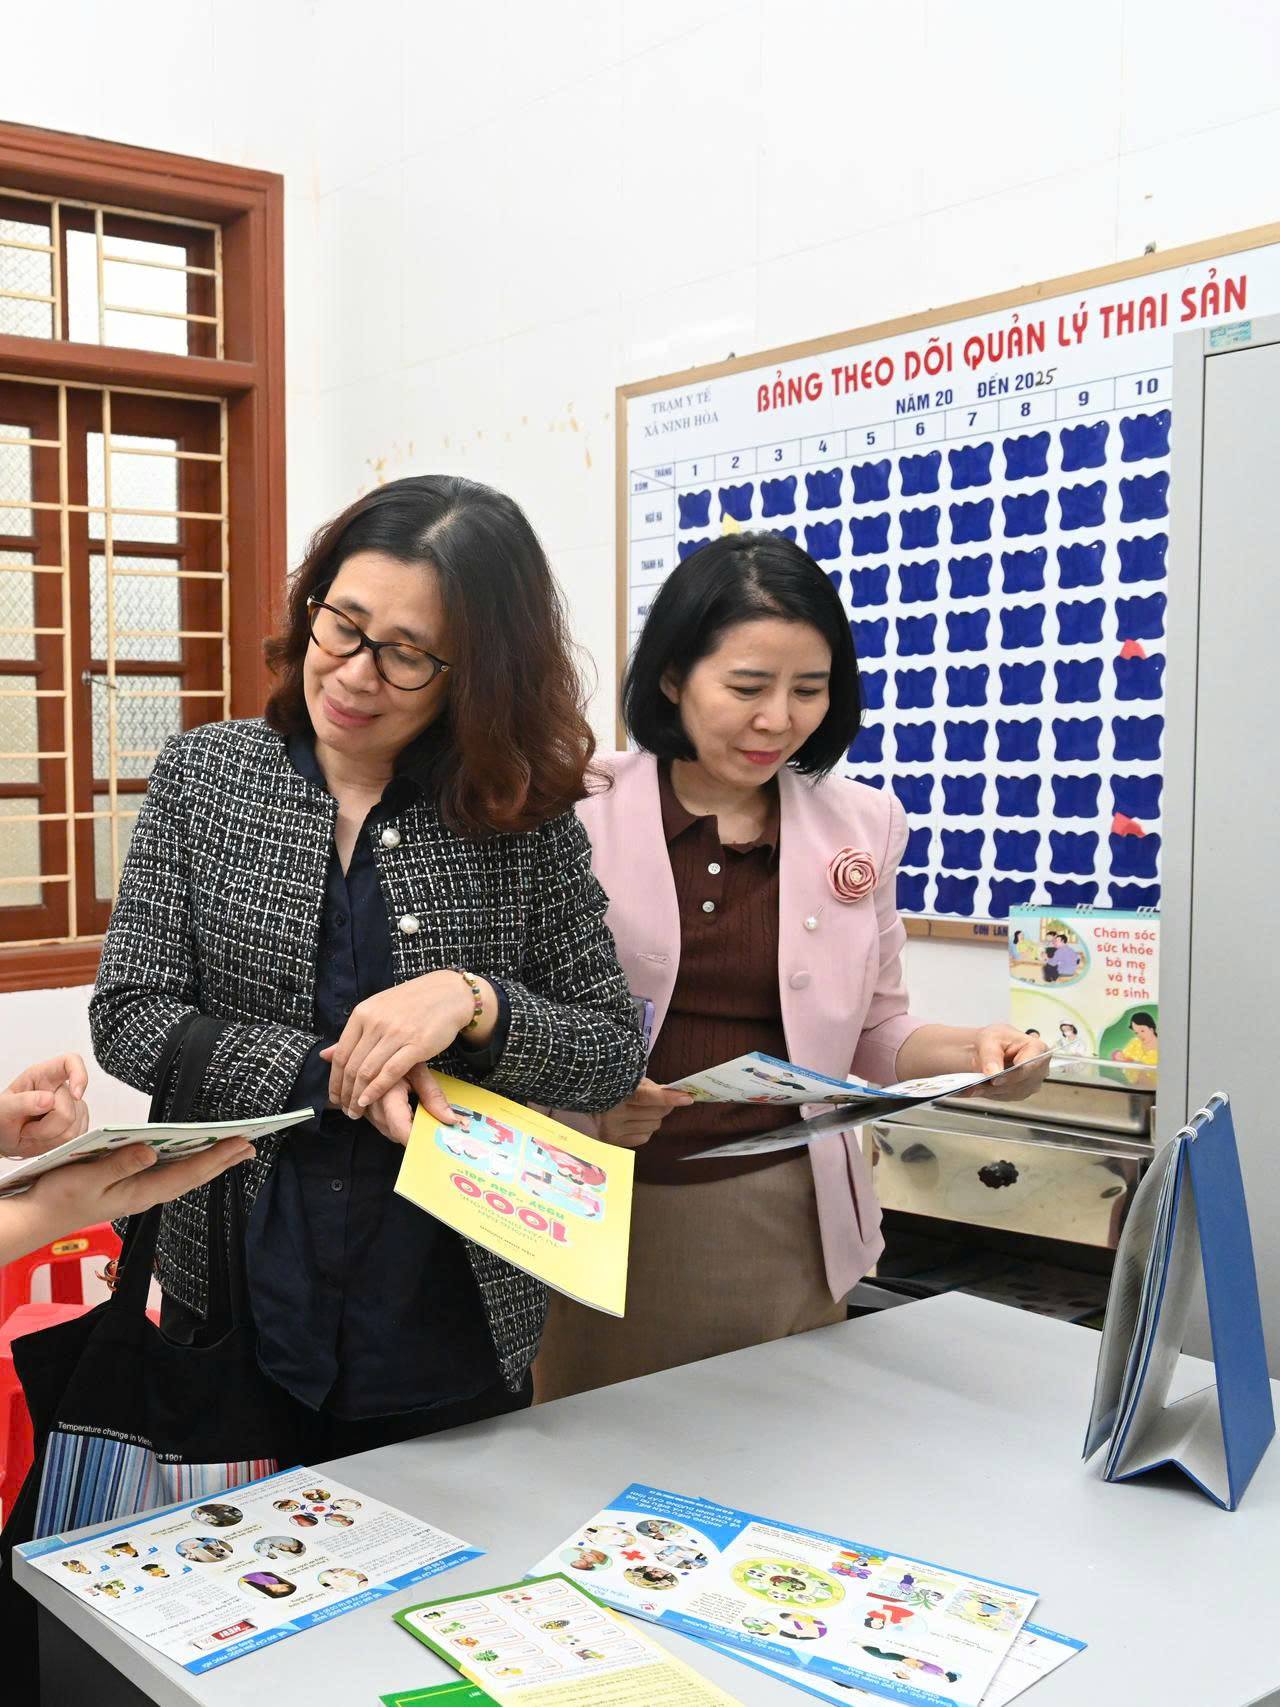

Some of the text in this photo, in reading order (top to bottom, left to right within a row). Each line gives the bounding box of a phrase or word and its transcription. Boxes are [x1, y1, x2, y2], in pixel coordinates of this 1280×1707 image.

[757, 370, 822, 412] BẢNG
[832, 356, 894, 396] THEO
[904, 336, 952, 381] DÕI
[964, 313, 1045, 370] QUẢN
[1058, 301, 1088, 347] LÝ
[1099, 292, 1168, 339] THAI
[1180, 267, 1247, 321] SẢN
[685, 394, 693, 407] Y
[896, 393, 930, 415] NĂM
[935, 389, 953, 406] 20
[977, 372, 1009, 398] ĐẾN
[662, 416, 690, 434] NINH
[692, 378, 1158, 476] 1 2 3 4 5 6 7 8 9 10
[1094, 927, 1156, 941] Chăm sóc
[1097, 941, 1118, 953] sức
[1106, 956, 1122, 968] bà
[1108, 971, 1123, 982] và
[1123, 987, 1150, 999] sinh
[450, 1173, 567, 1243] 1000
[58, 1421, 102, 1435] Temperature
[102, 1428, 129, 1441] change
[130, 1433, 137, 1441] in
[165, 1452, 183, 1462] 1901
